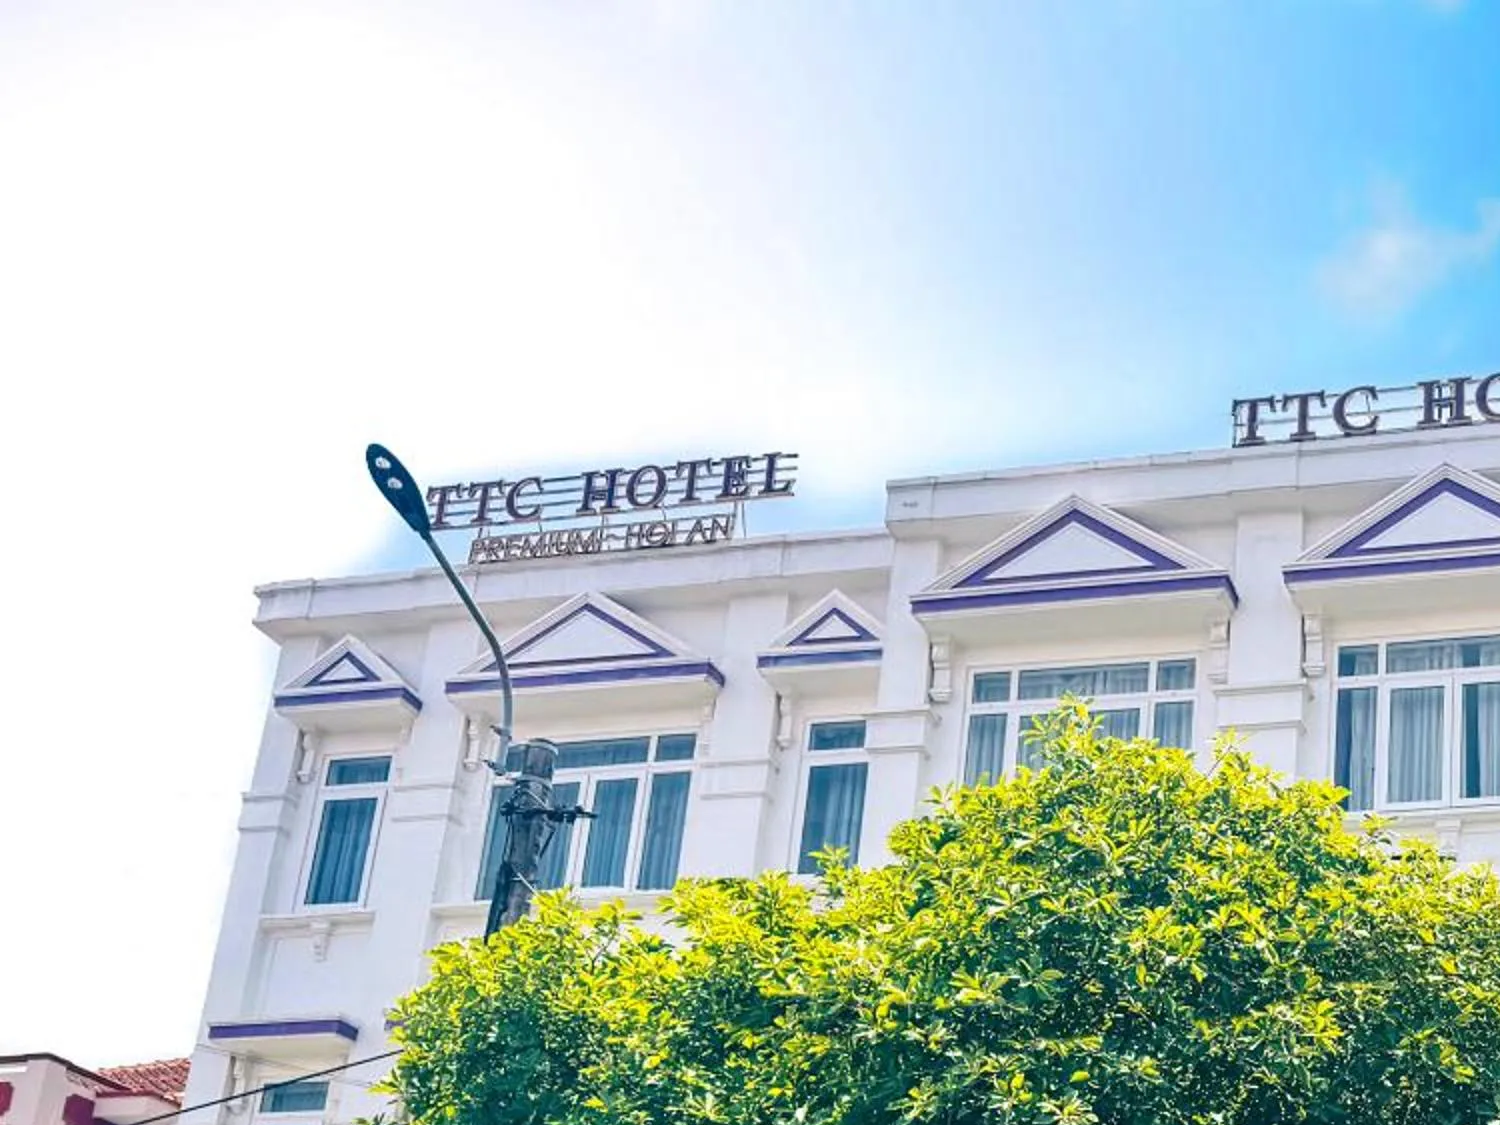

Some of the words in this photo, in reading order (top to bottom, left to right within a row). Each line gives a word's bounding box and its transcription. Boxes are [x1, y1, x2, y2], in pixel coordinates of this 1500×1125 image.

[1233, 386, 1379, 445] TTC
[427, 477, 543, 529] TTC
[576, 453, 796, 516] HOTEL
[471, 531, 602, 563] PREMIUM
